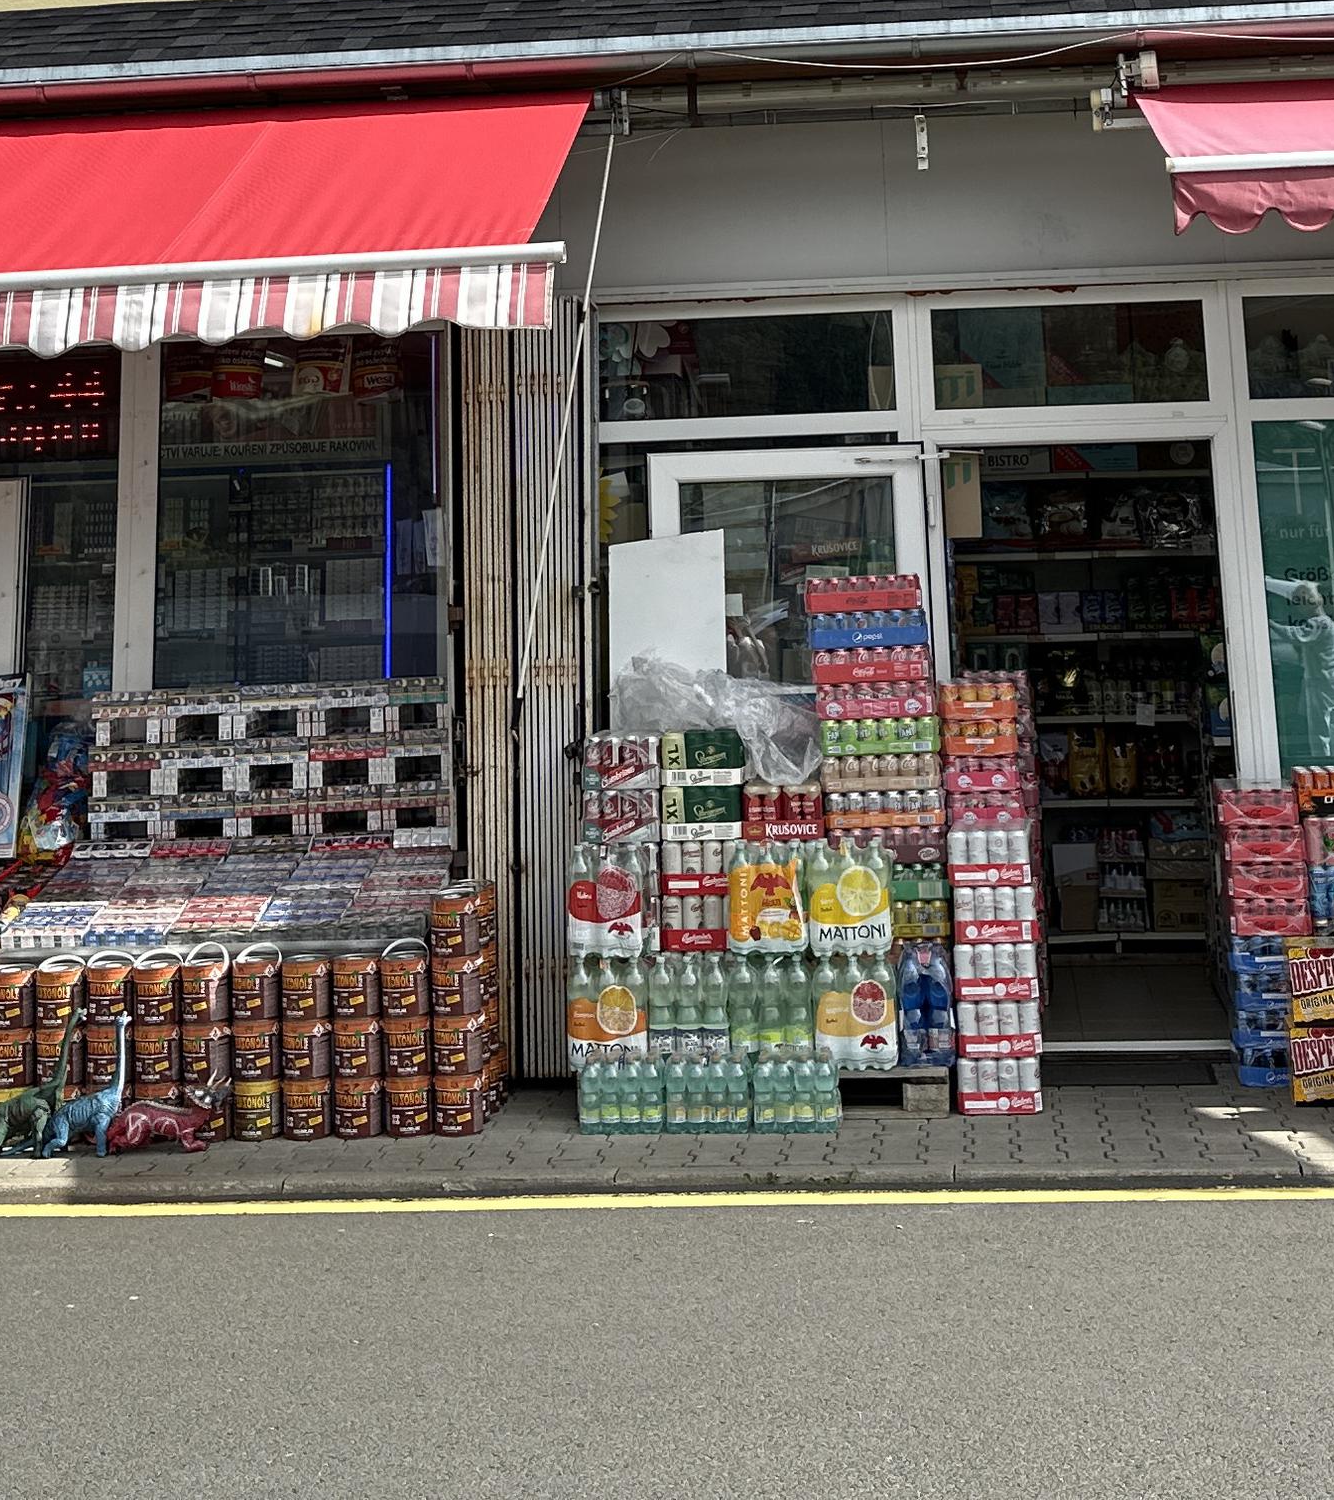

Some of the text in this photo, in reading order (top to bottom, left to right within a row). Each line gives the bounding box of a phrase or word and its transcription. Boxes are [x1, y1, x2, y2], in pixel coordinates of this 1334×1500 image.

[987, 453, 1029, 468] BISTRO
[1279, 527, 1305, 539] nur
[667, 743, 678, 766] XL
[667, 798, 678, 819] XL
[765, 822, 818, 839] KRUŠOVICE
[739, 872, 749, 938] MATTONI
[819, 924, 886, 942] MATTONI
[571, 1042, 638, 1058] MATTON
